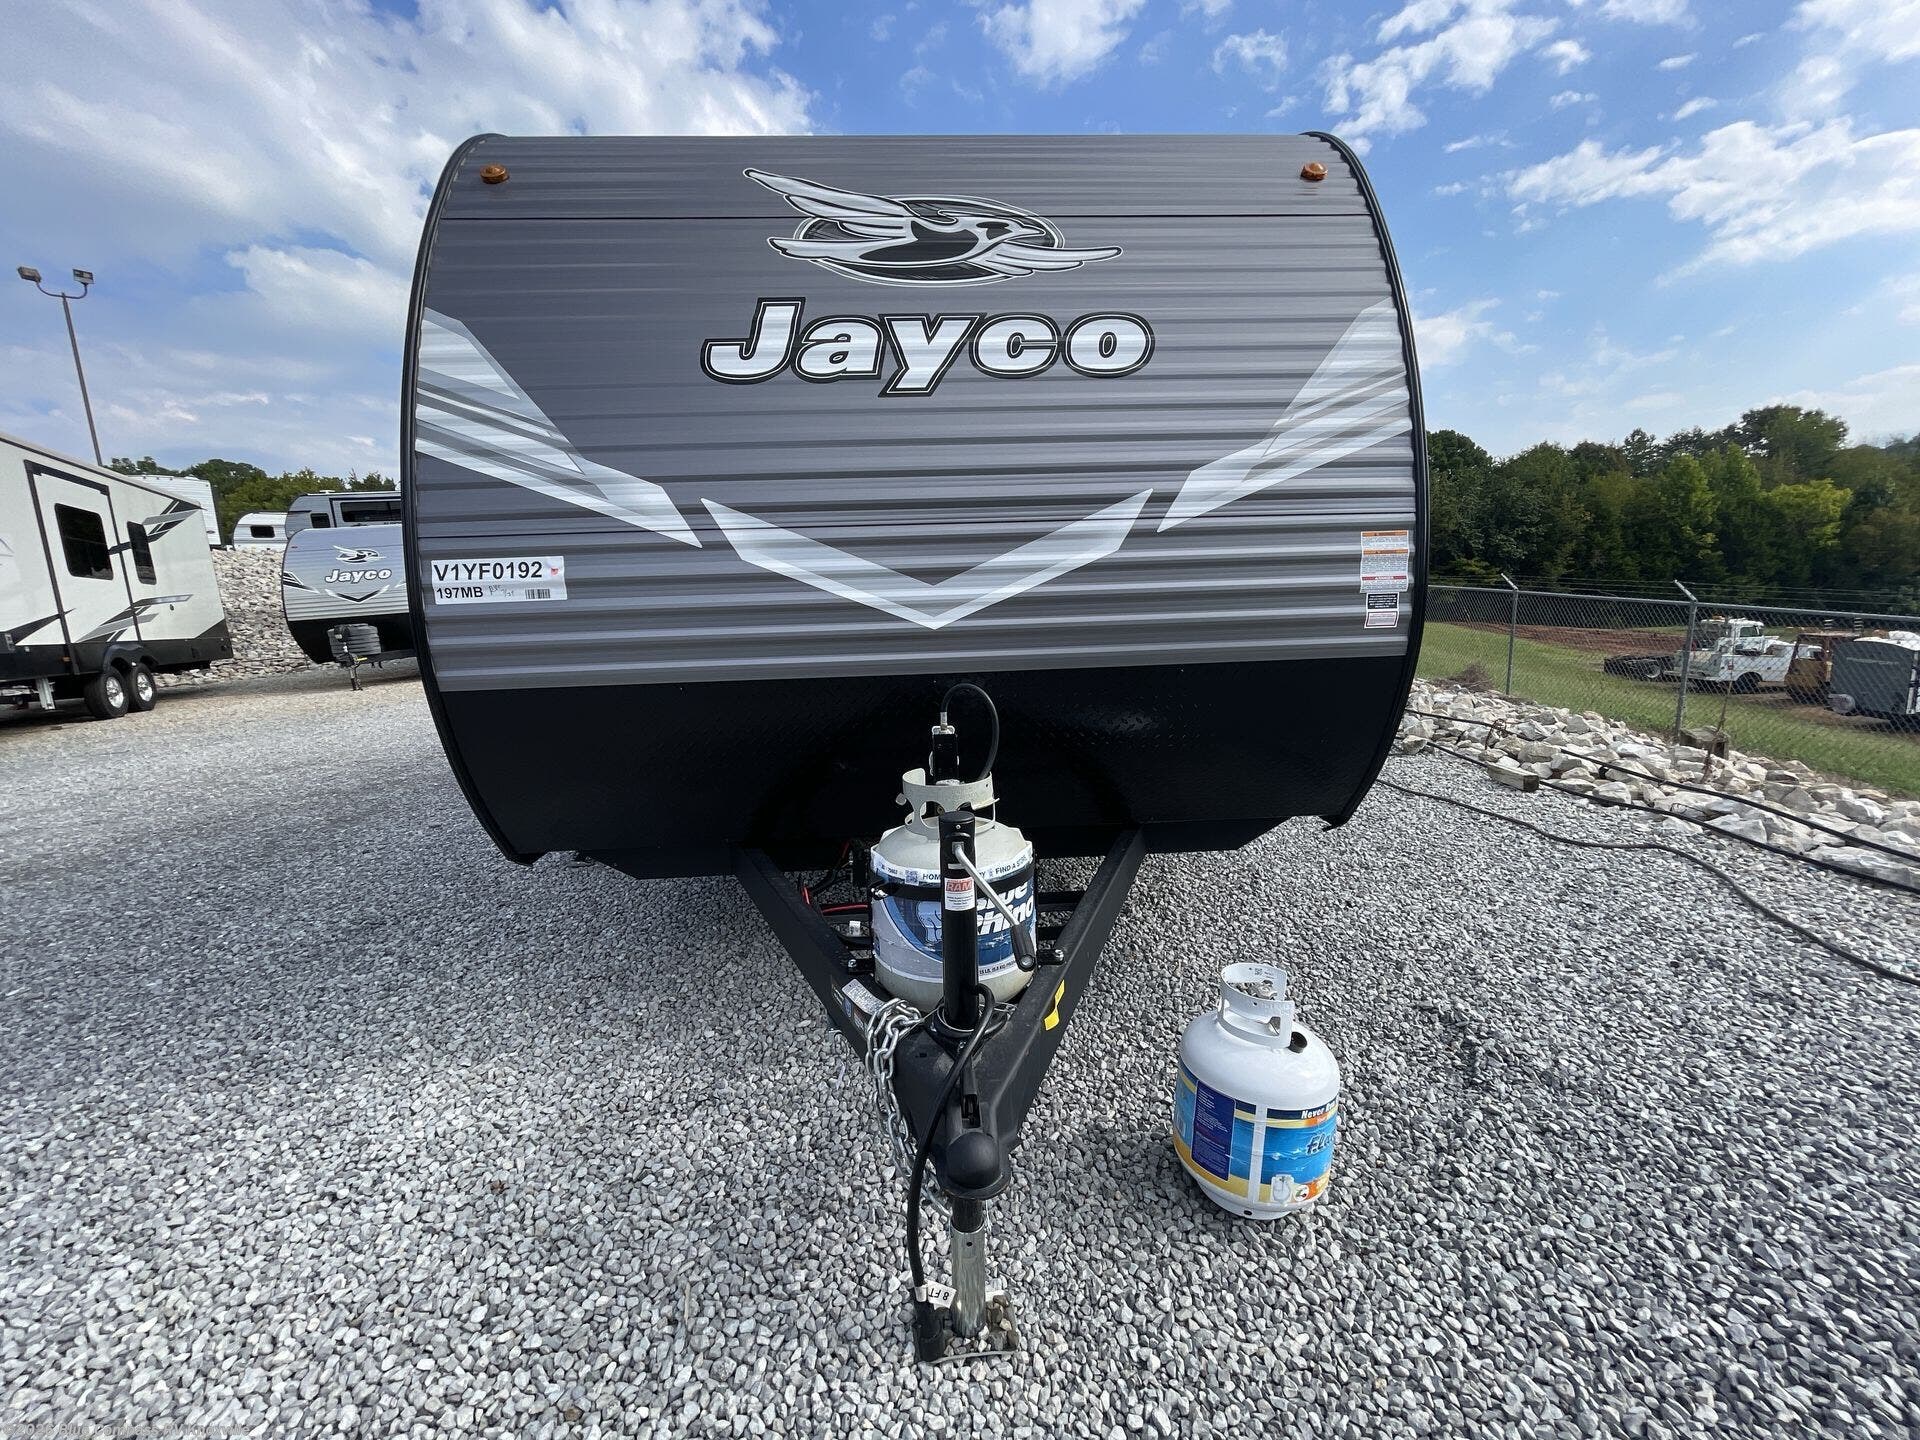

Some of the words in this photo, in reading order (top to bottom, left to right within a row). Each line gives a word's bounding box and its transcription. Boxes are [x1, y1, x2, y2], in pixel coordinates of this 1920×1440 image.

[700, 297, 1156, 397] Jayco
[325, 568, 392, 584] Jayco
[434, 561, 542, 581] V1YF0192
[436, 586, 484, 599] 197MB
[922, 873, 940, 881] HOM
[946, 880, 972, 891] RAM
[928, 1287, 941, 1298] FT
[943, 1291, 950, 1301] 8
